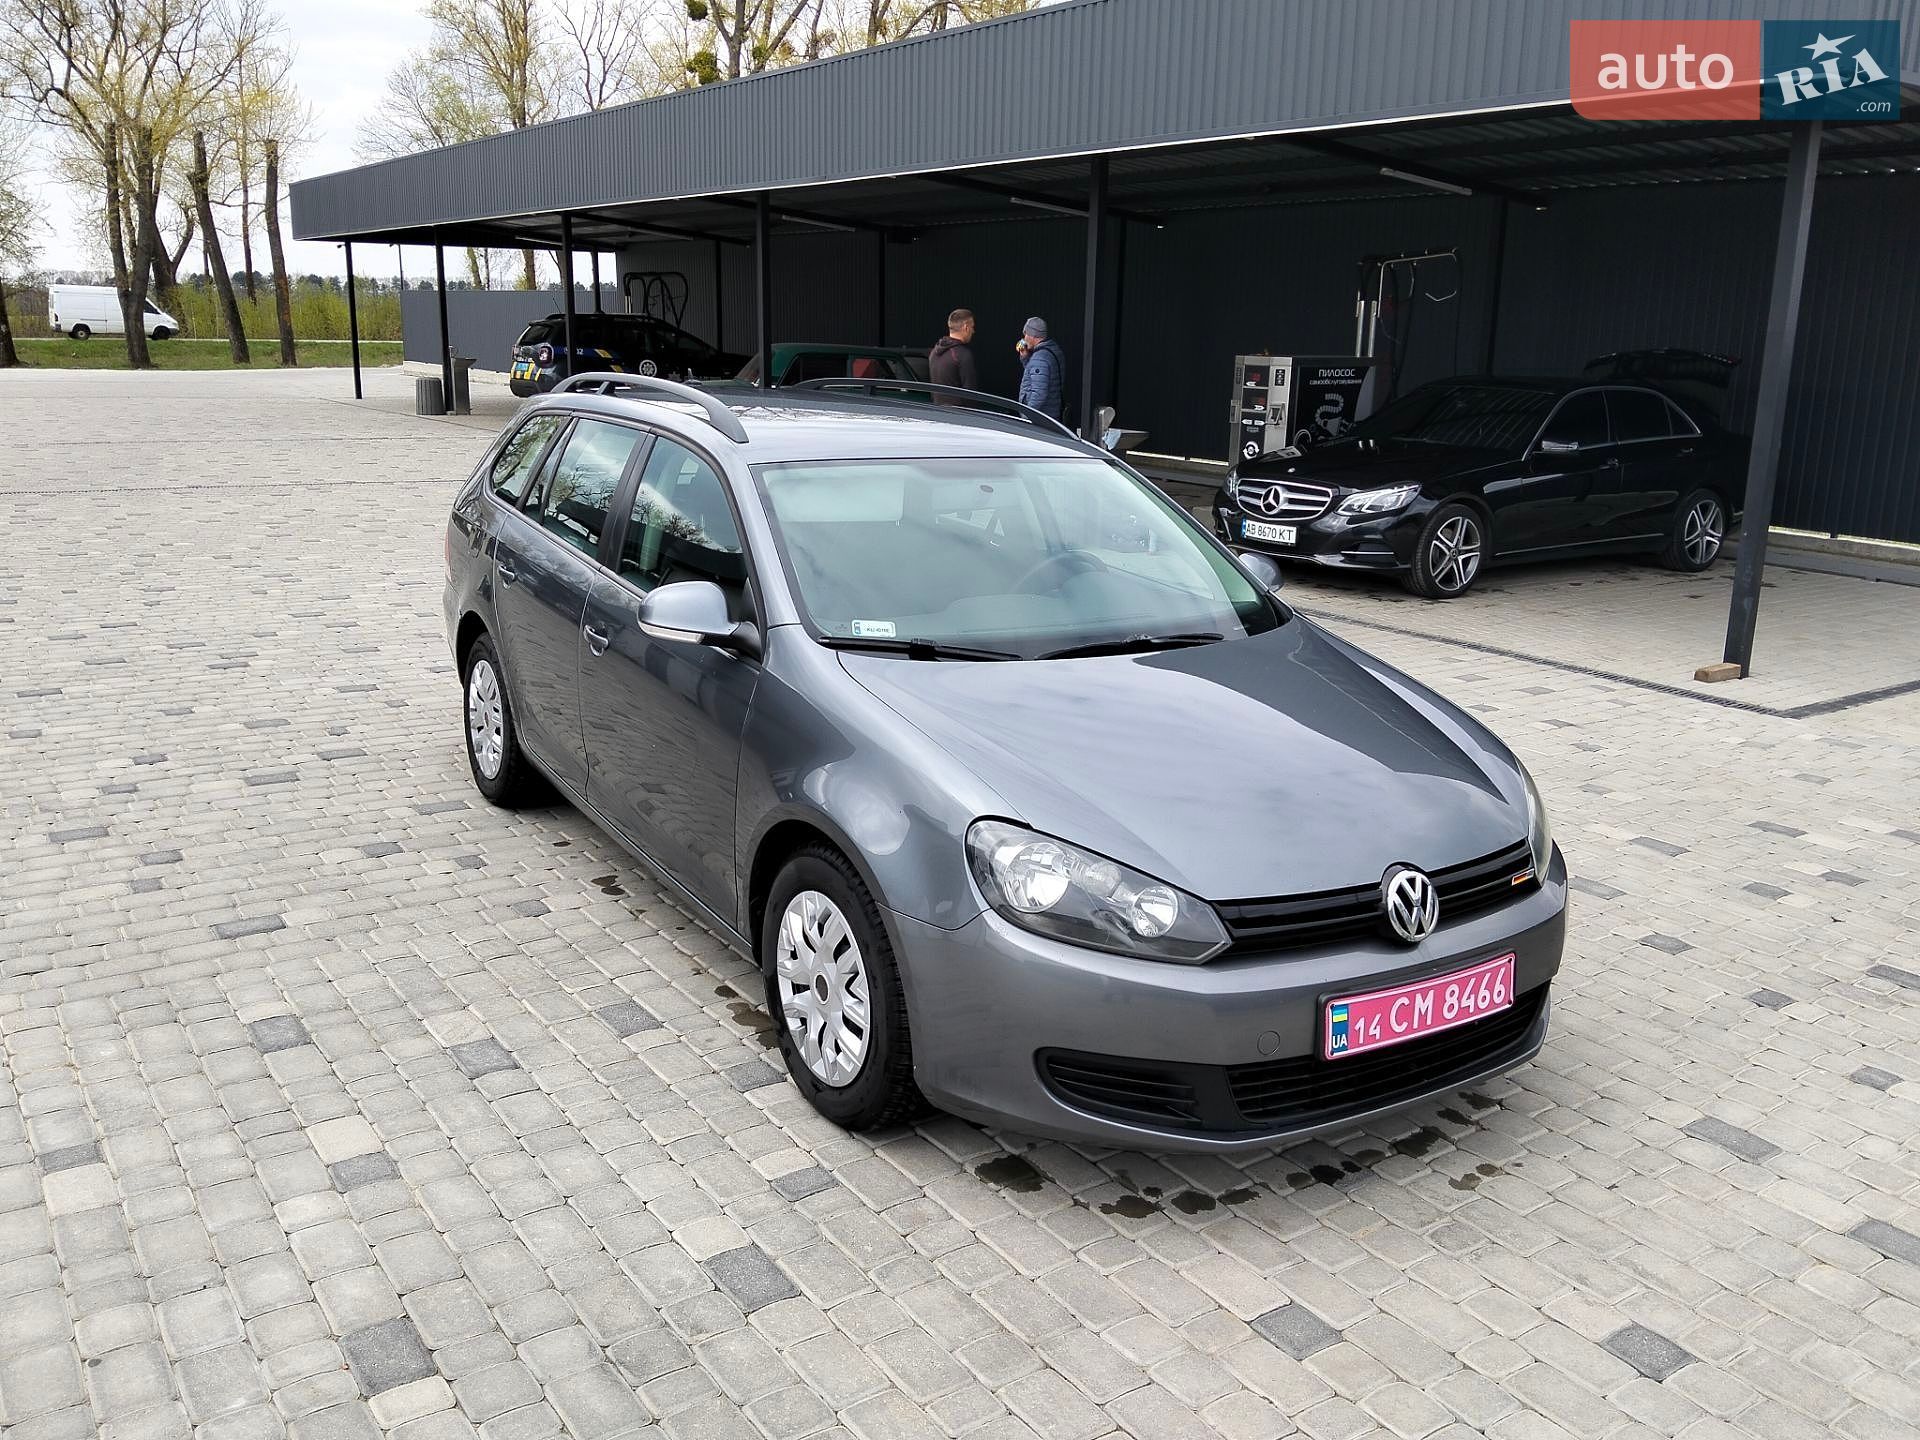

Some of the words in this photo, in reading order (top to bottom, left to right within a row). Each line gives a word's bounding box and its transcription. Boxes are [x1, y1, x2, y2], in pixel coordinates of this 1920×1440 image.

[1318, 368, 1356, 378] ПИЛОСОС
[1354, 1012, 1383, 1044] 14
[1389, 989, 1436, 1033] CM
[1442, 967, 1506, 1020] 8466
[1332, 1034, 1348, 1049] UA
